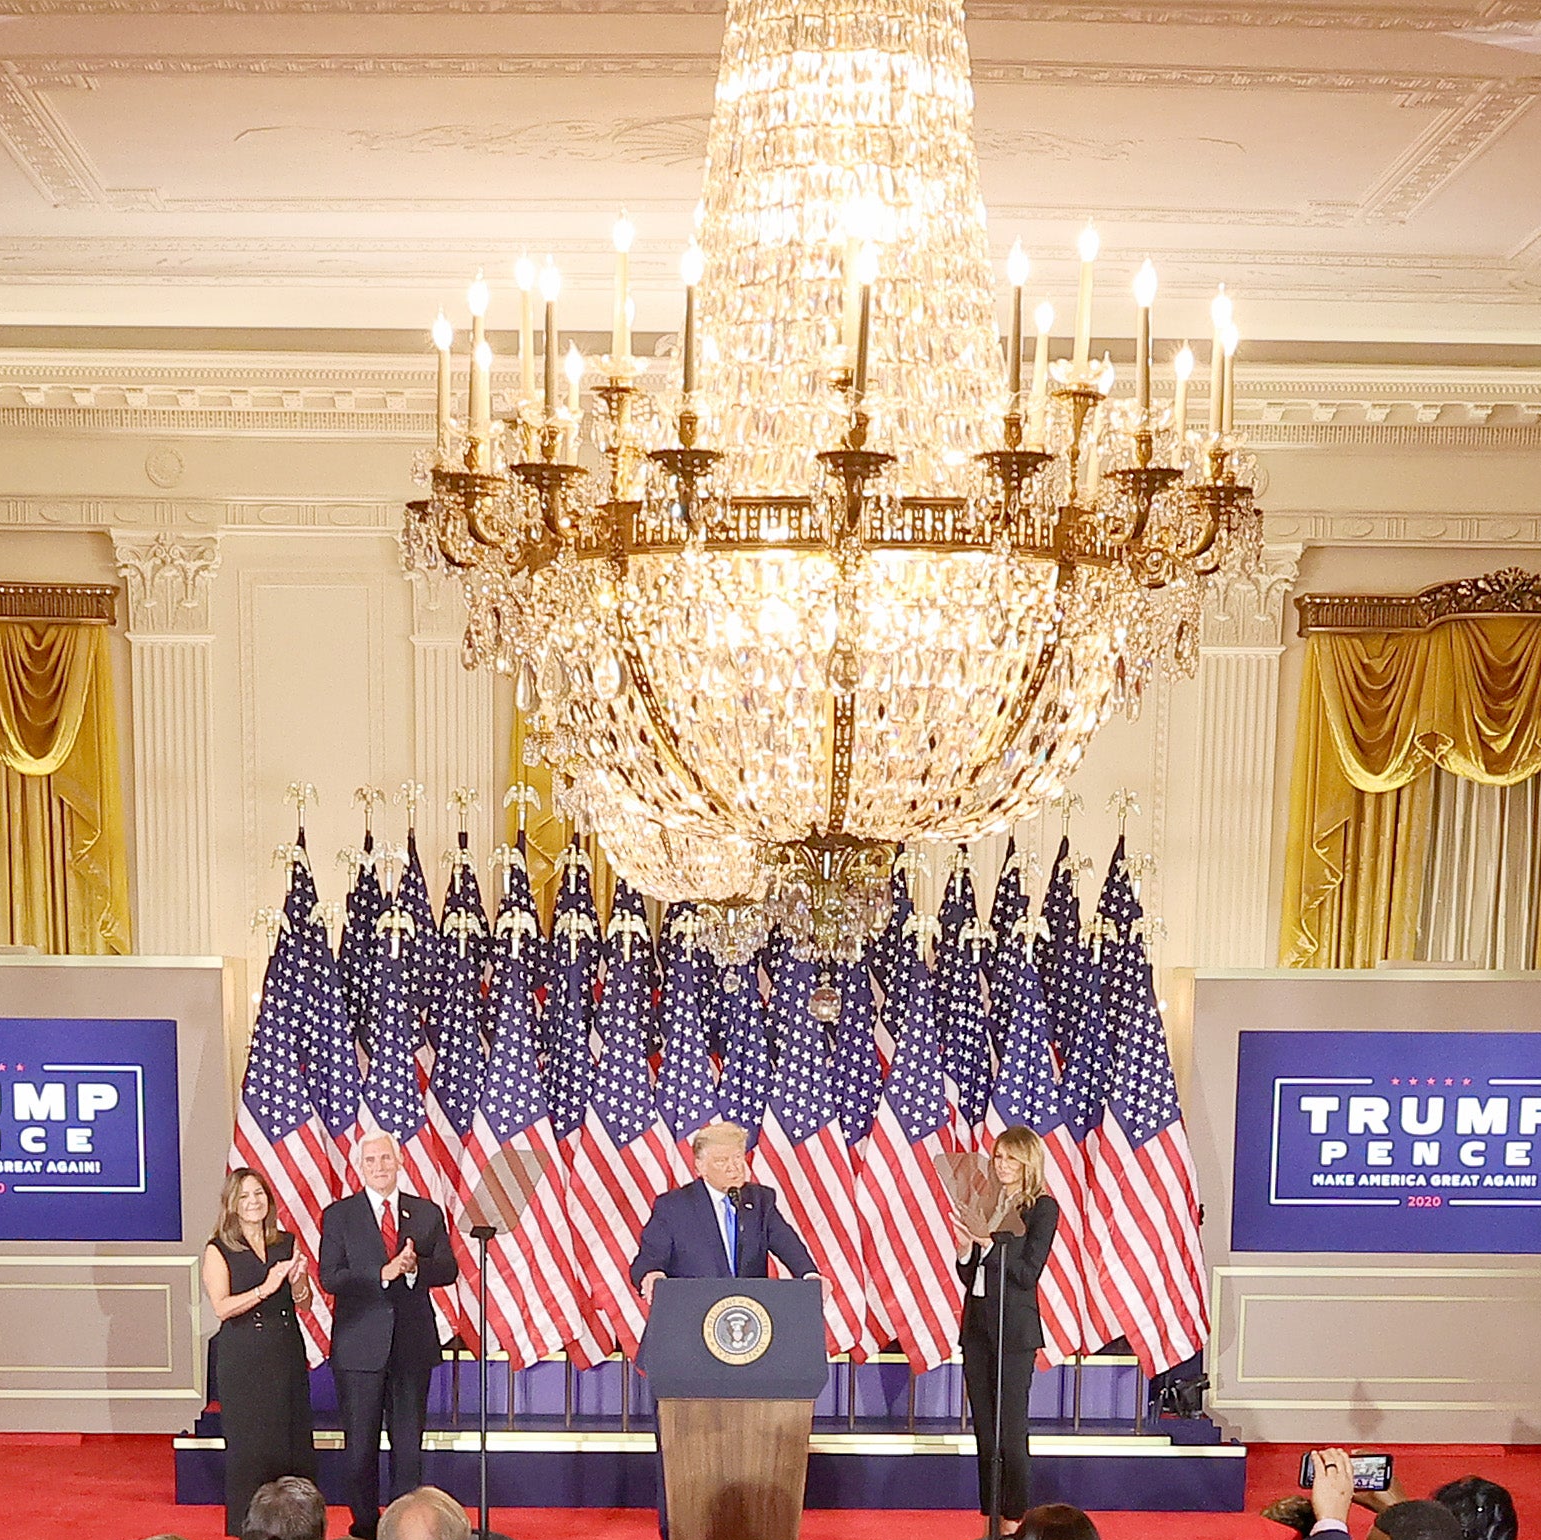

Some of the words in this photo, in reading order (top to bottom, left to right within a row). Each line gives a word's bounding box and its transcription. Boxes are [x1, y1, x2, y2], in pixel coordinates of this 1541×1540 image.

[1320, 1141, 1532, 1166] PENCE
[46, 1161, 101, 1174] AGAIN!
[1312, 1174, 1355, 1186] MAKE
[1358, 1174, 1427, 1187] AMERICA
[1430, 1174, 1480, 1187] GREAT
[1482, 1174, 1537, 1187] AGAIN!
[1408, 1196, 1441, 1208] 2020
